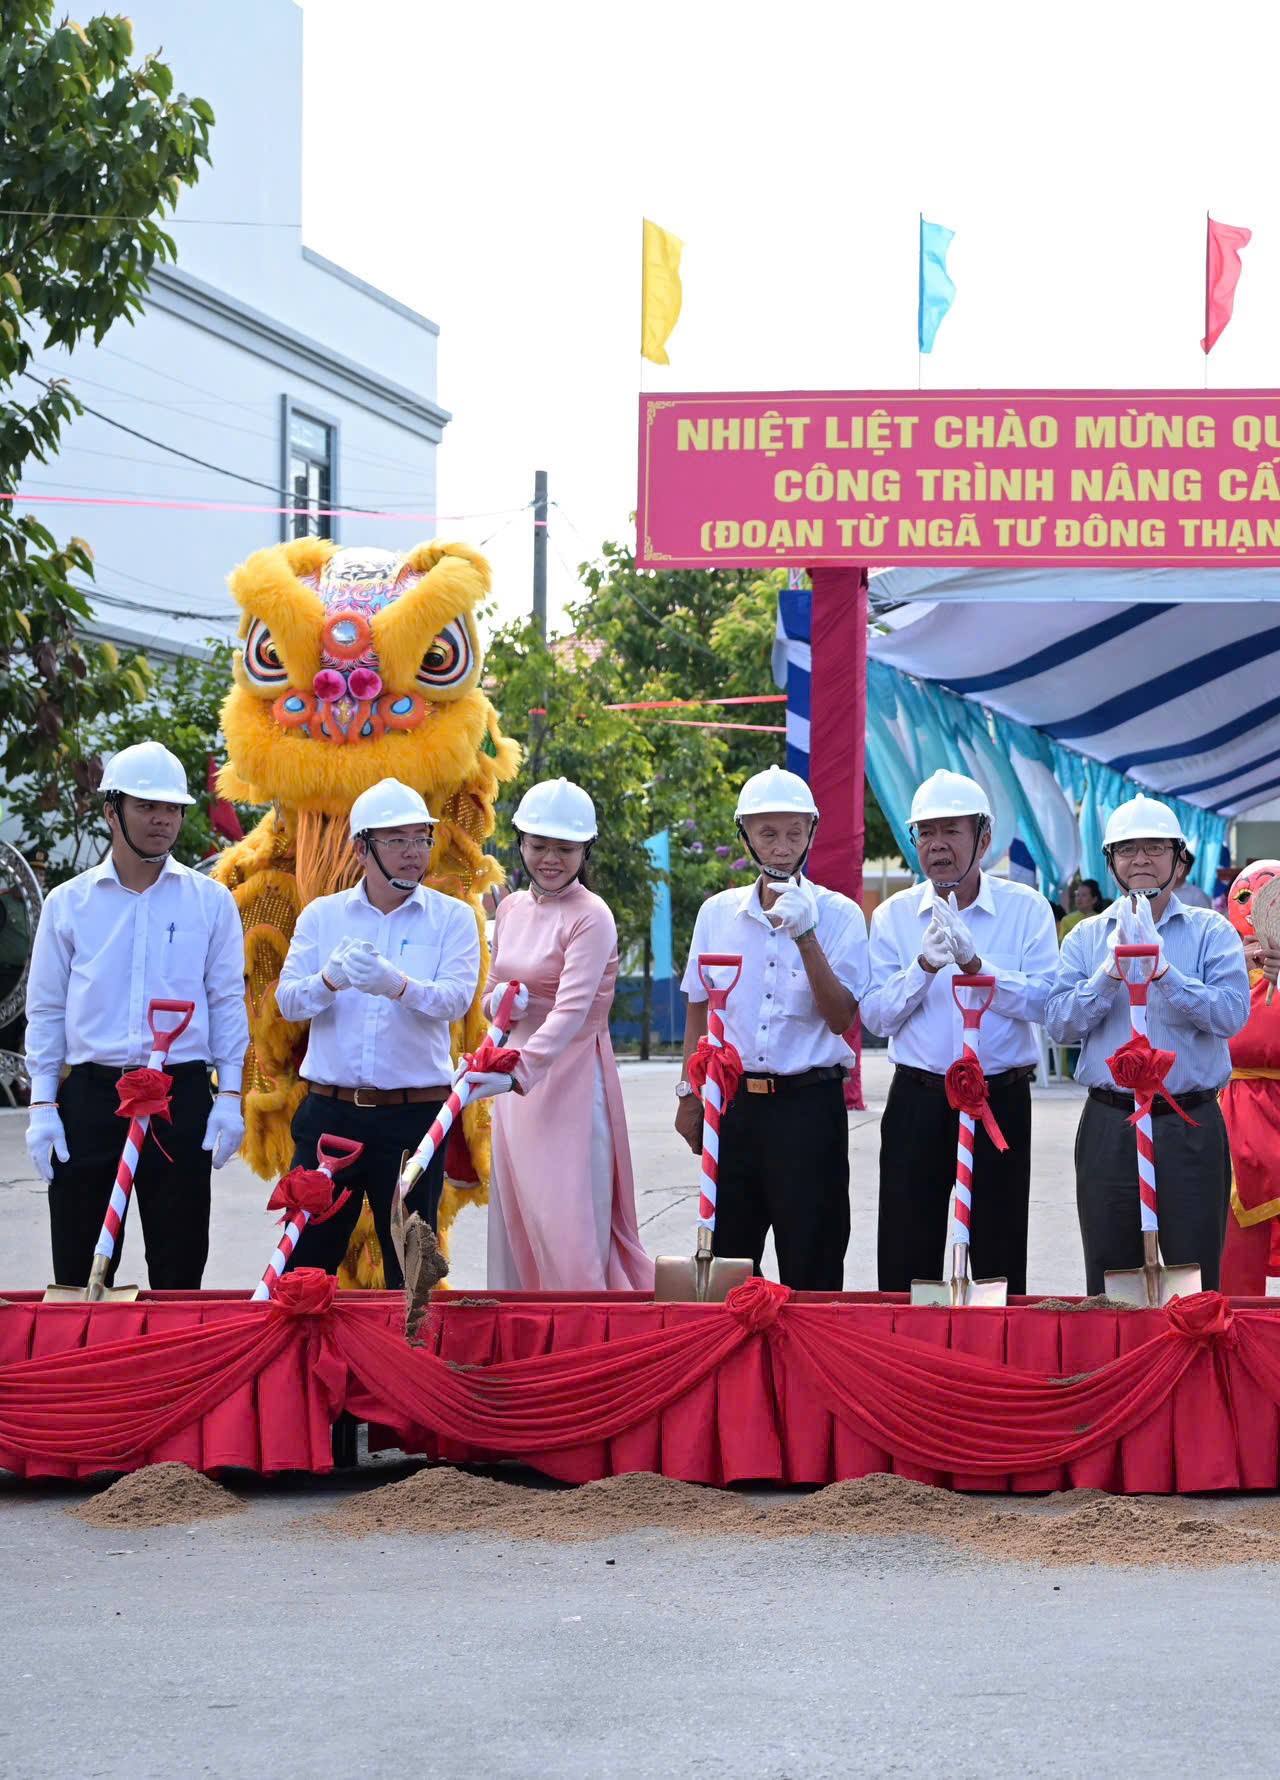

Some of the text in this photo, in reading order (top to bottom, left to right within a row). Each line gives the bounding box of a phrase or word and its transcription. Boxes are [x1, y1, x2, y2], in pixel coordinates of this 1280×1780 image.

[678, 410, 810, 457] NHIỆT
[826, 409, 919, 456] LIỆT
[935, 408, 1059, 449] CHÀO
[1076, 408, 1216, 449] MỪNG
[775, 462, 901, 503] CÔNG
[917, 462, 1054, 502] TRÌNH
[1071, 462, 1202, 502] NÂNG
[701, 518, 824, 554] (ĐOẠN
[837, 512, 889, 548] TỪ
[899, 512, 982, 548] NGÃ
[994, 516, 1047, 547] TƯ
[1055, 513, 1166, 548] ĐÔNG
